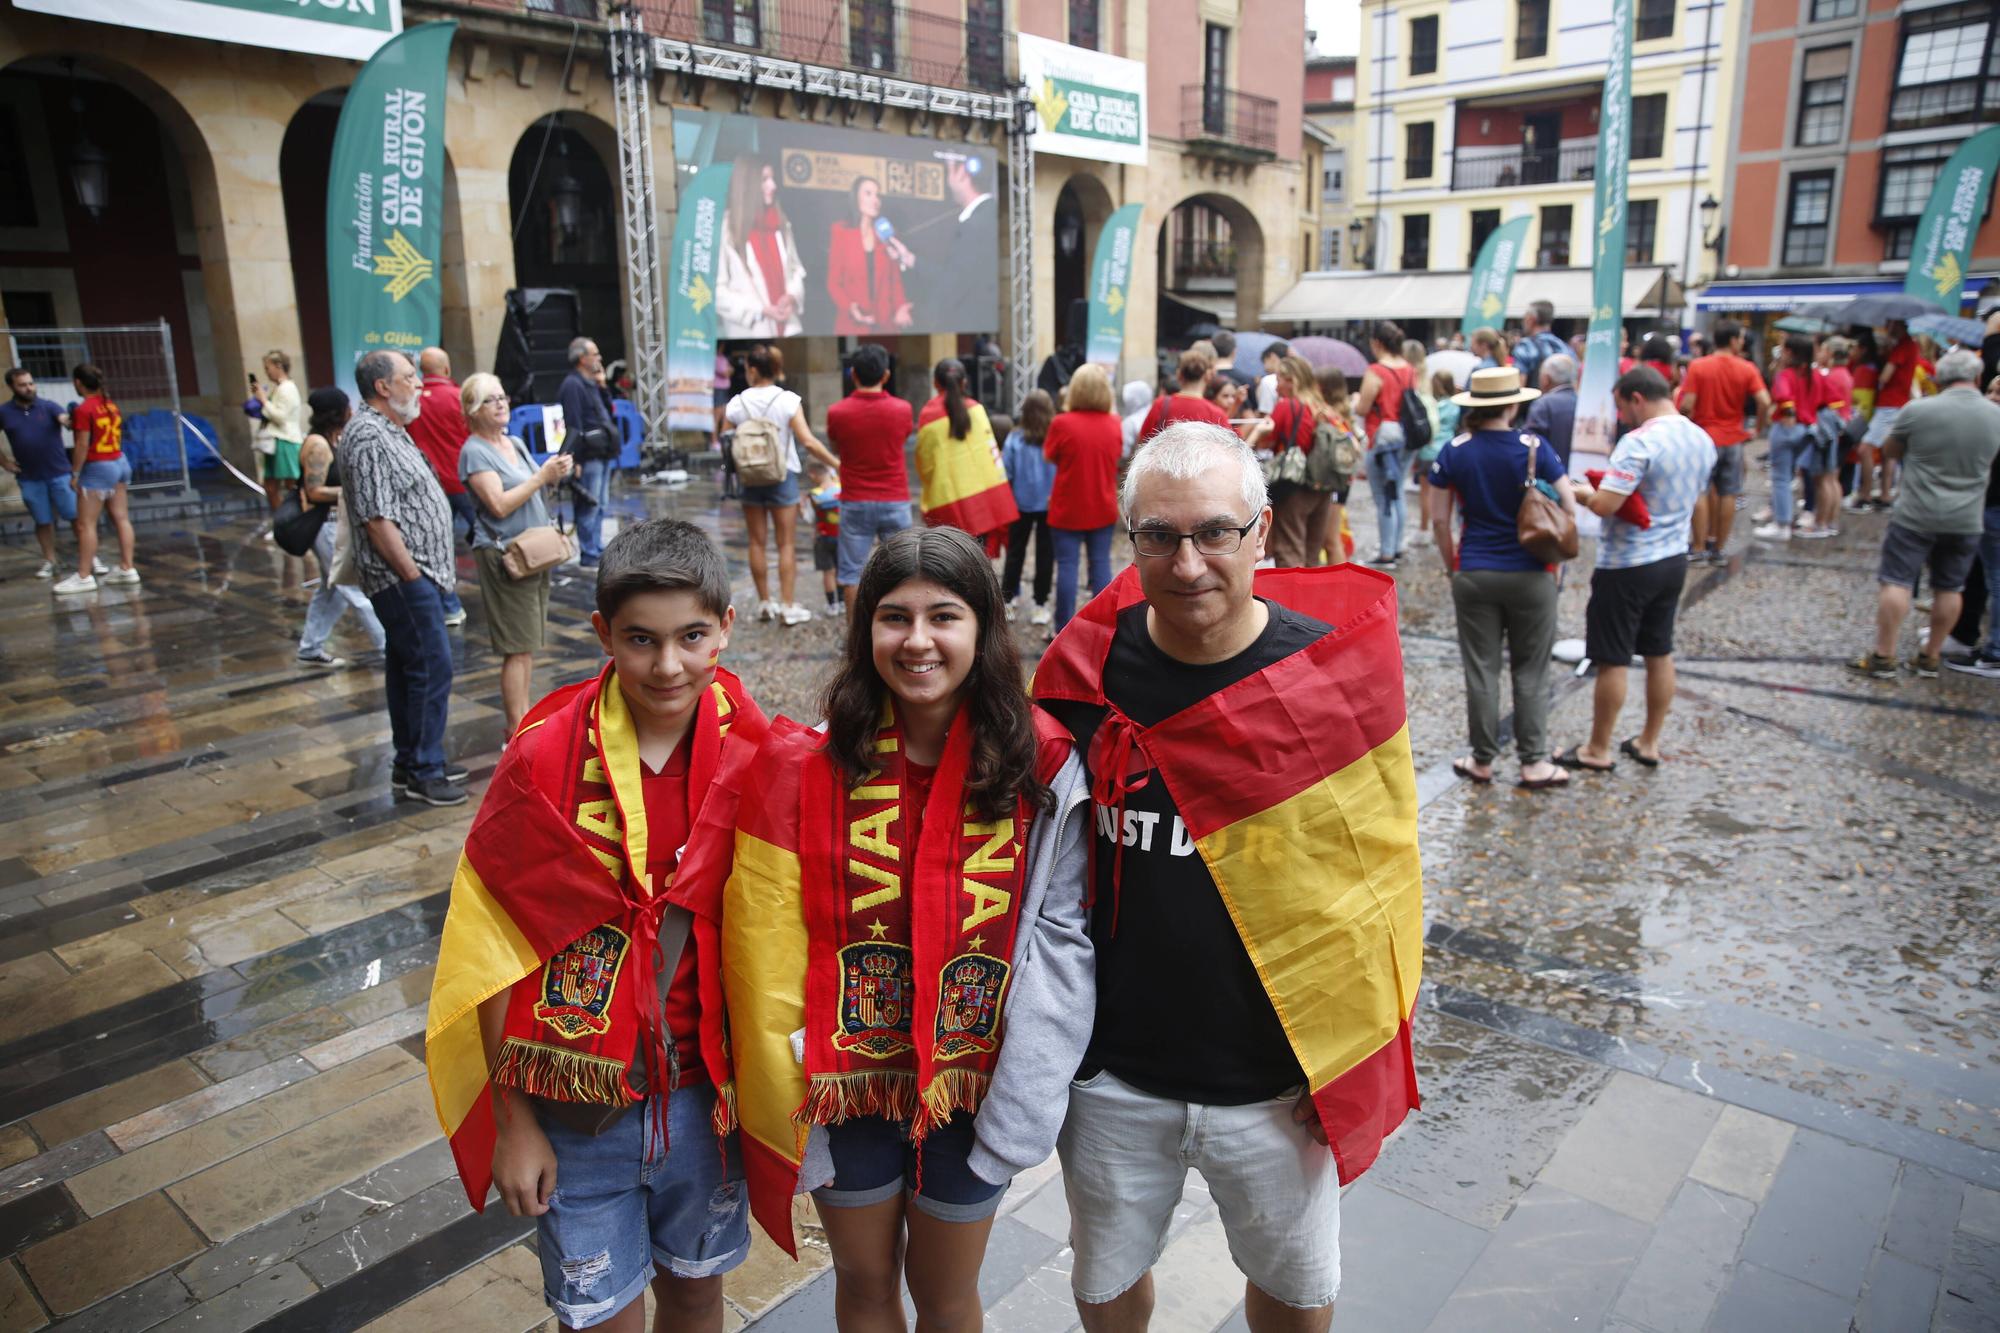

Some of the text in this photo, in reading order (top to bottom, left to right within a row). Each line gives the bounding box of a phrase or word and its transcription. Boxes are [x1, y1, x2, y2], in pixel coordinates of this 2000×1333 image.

[1070, 108, 1093, 131] DE
[382, 88, 402, 226] CAJA RURAL
[352, 172, 373, 273] Fundación
[401, 186, 422, 227] DE
[364, 331, 380, 344] de
[1096, 804, 1161, 852] JUST
